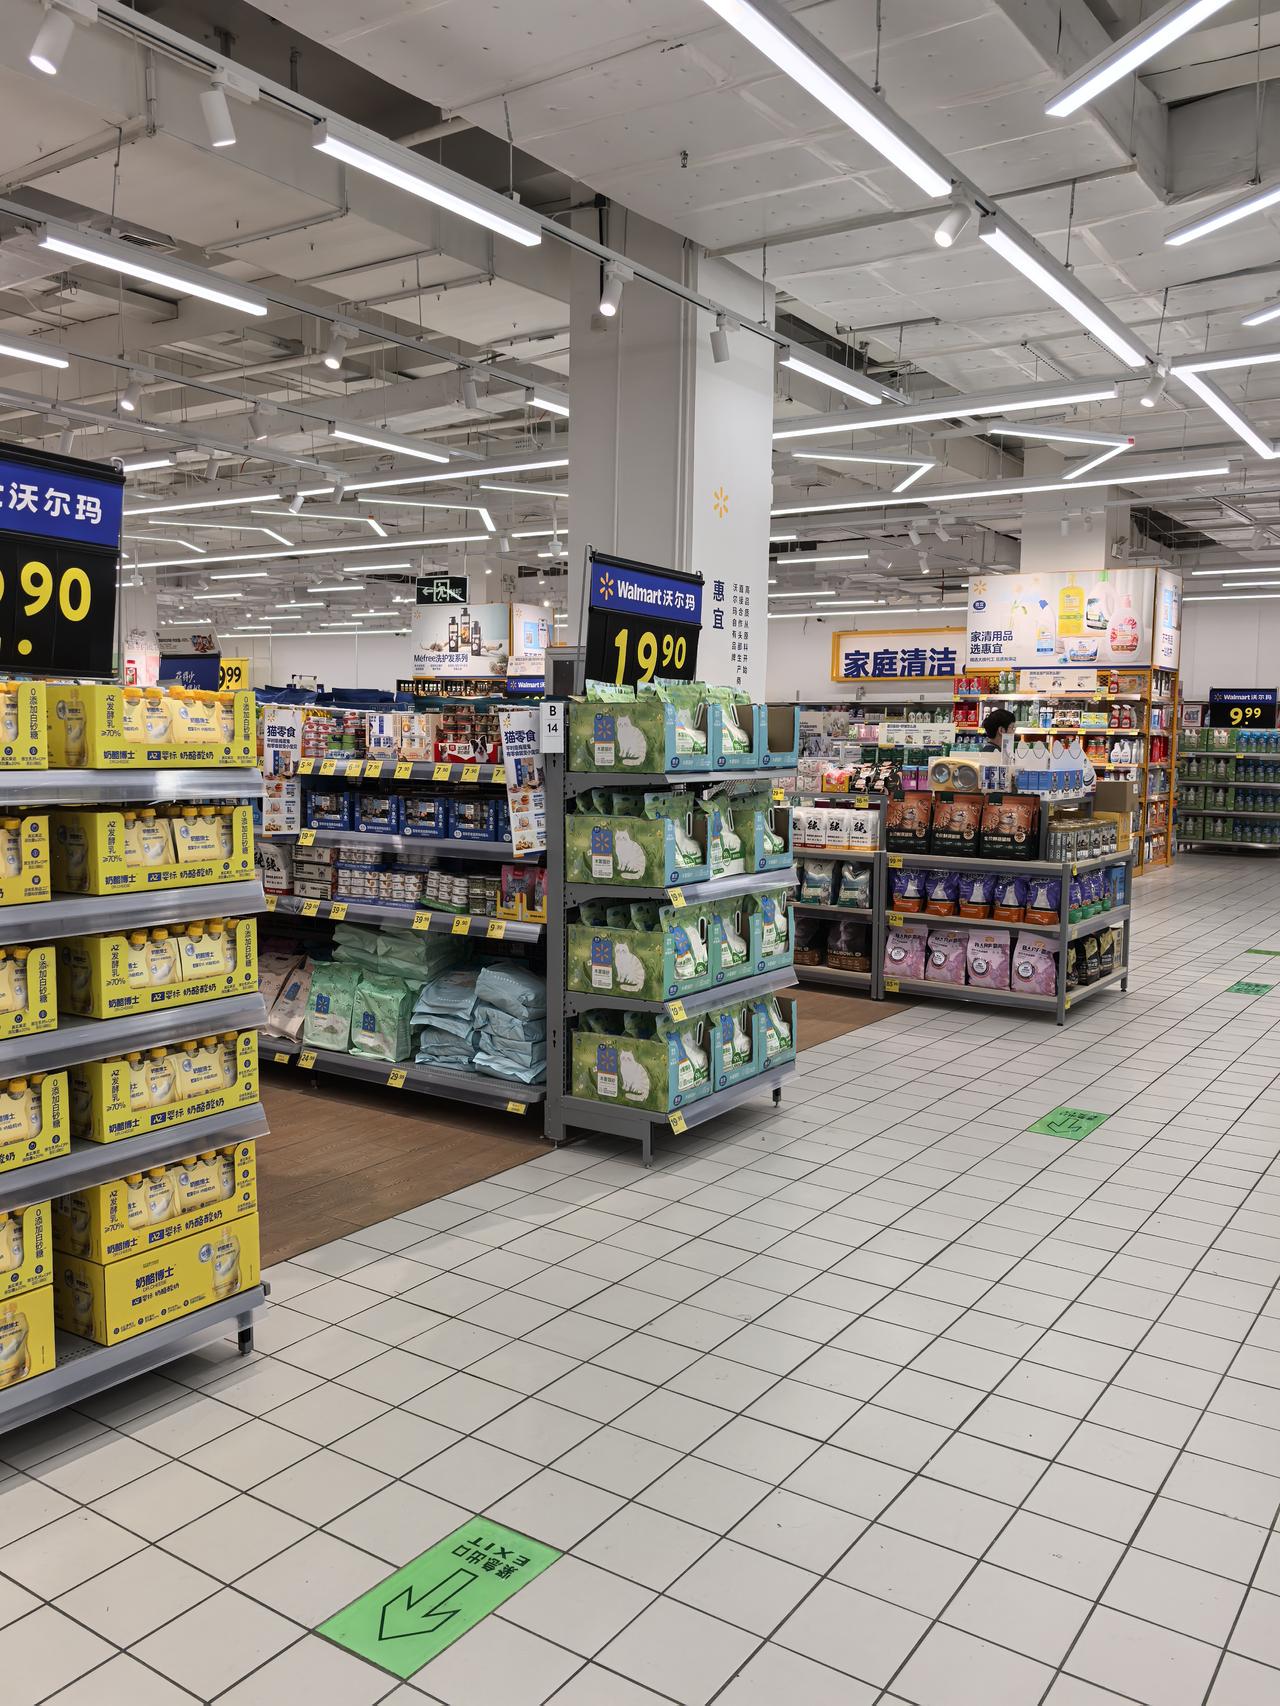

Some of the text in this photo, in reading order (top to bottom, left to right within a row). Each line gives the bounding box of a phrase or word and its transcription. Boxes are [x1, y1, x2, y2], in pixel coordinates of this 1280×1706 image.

[8, 482, 102, 525] 沃尔玛
[617, 579, 695, 611] Walmart 沃尔玛
[713, 579, 725, 630] 惠宜
[970, 631, 1013, 642] 家清用品
[970, 643, 1003, 655] 选惠宜
[843, 647, 957, 678] 家庭清洁
[549, 706, 557, 716] B
[1229, 707, 1261, 726] 9.99
[267, 725, 296, 738] 猫零食
[547, 723, 559, 733] 14
[504, 729, 536, 744] 猫零食
[103, 750, 135, 760] 奶酪博士
[105, 874, 136, 885] 奶酪博士
[108, 995, 140, 1008] 奶酪博士
[108, 1118, 140, 1134] 奶酪博士
[106, 1238, 139, 1254] 奶酪博士
[135, 1266, 175, 1290] 奶酪博士
[467, 1536, 531, 1566] EXIT
[451, 1544, 519, 1580] 紧急出口
